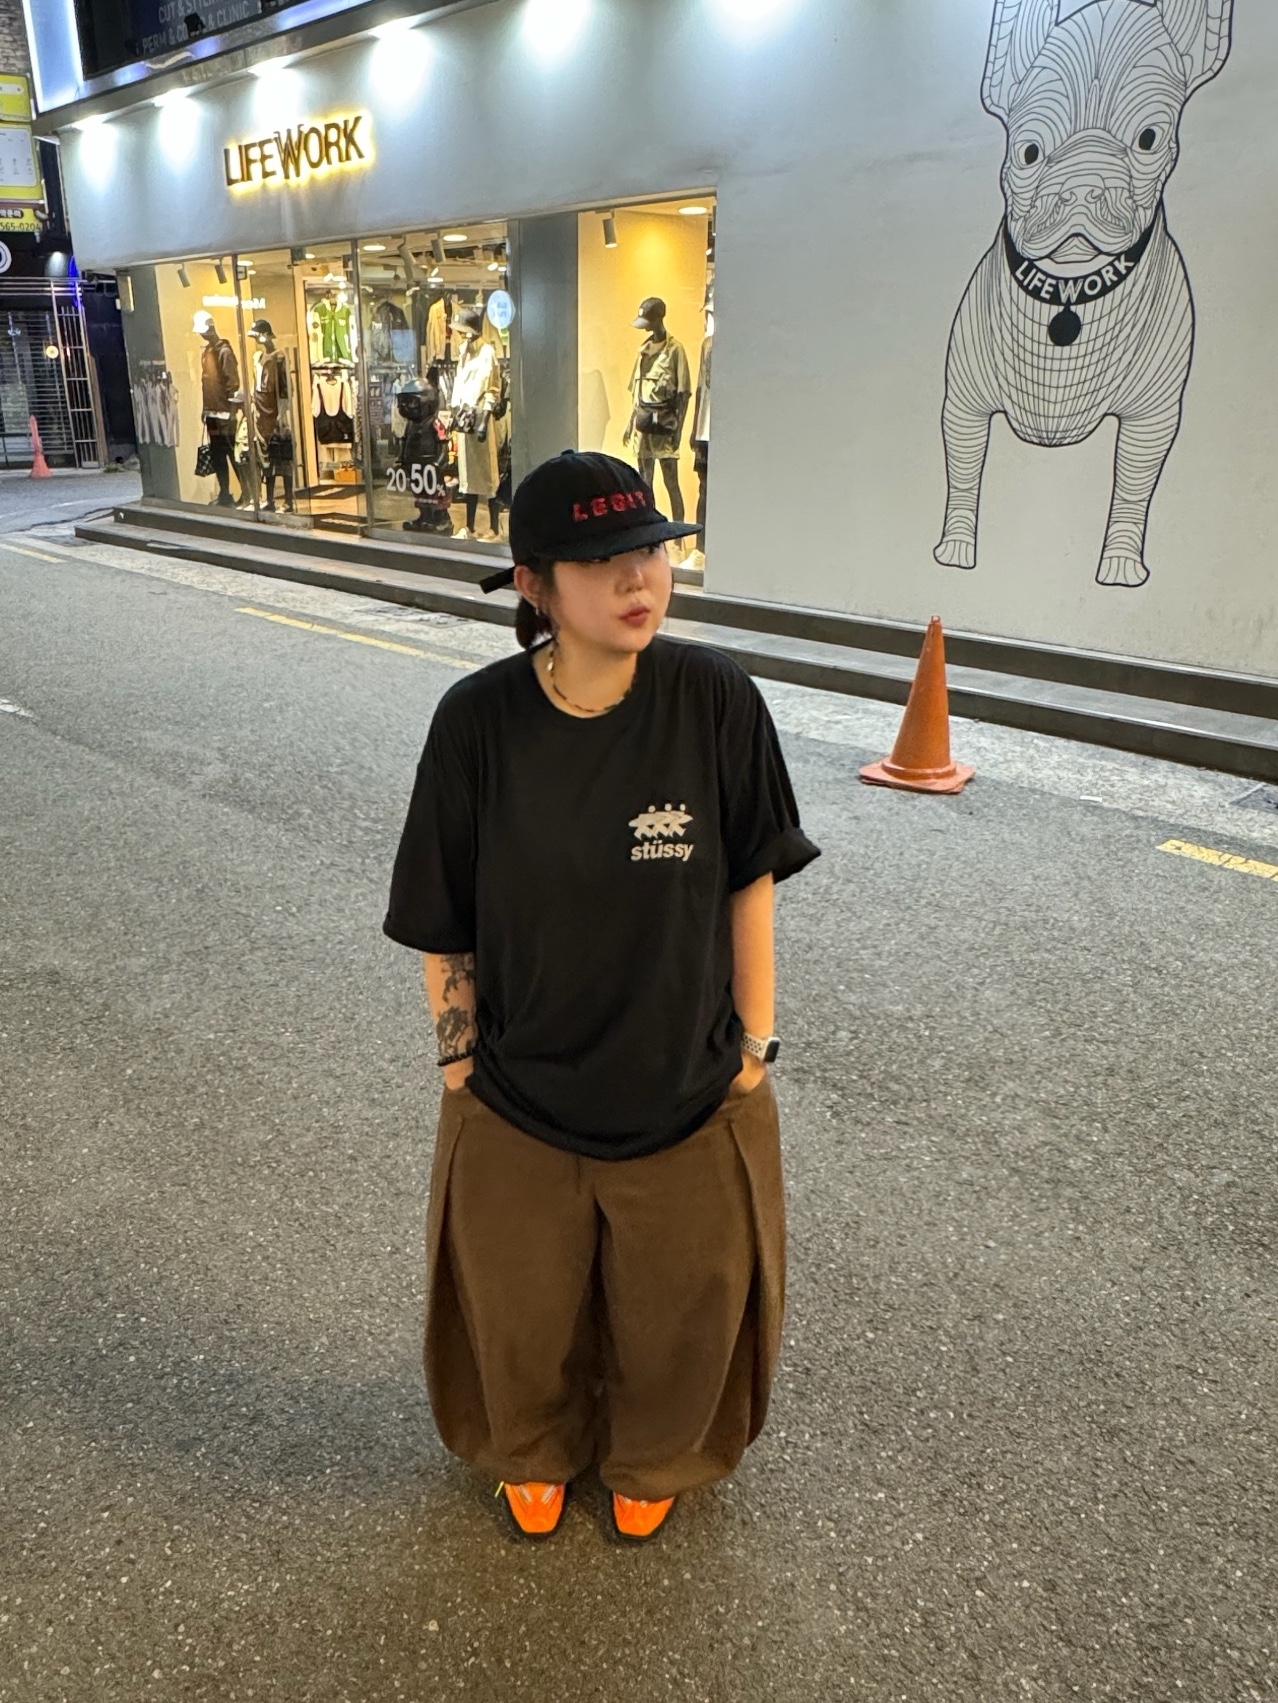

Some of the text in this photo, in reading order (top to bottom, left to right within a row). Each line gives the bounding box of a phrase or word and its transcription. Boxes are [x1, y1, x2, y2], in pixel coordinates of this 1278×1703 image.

[142, 31, 167, 55] PERM
[168, 27, 175, 45] &
[207, 13, 215, 30] &
[216, 0, 250, 26] CLINIC
[158, 2, 176, 24] CUT
[223, 116, 365, 186] LIFEWORK
[1014, 253, 1135, 304] LIFEWORK
[630, 840, 695, 862] stüssy
